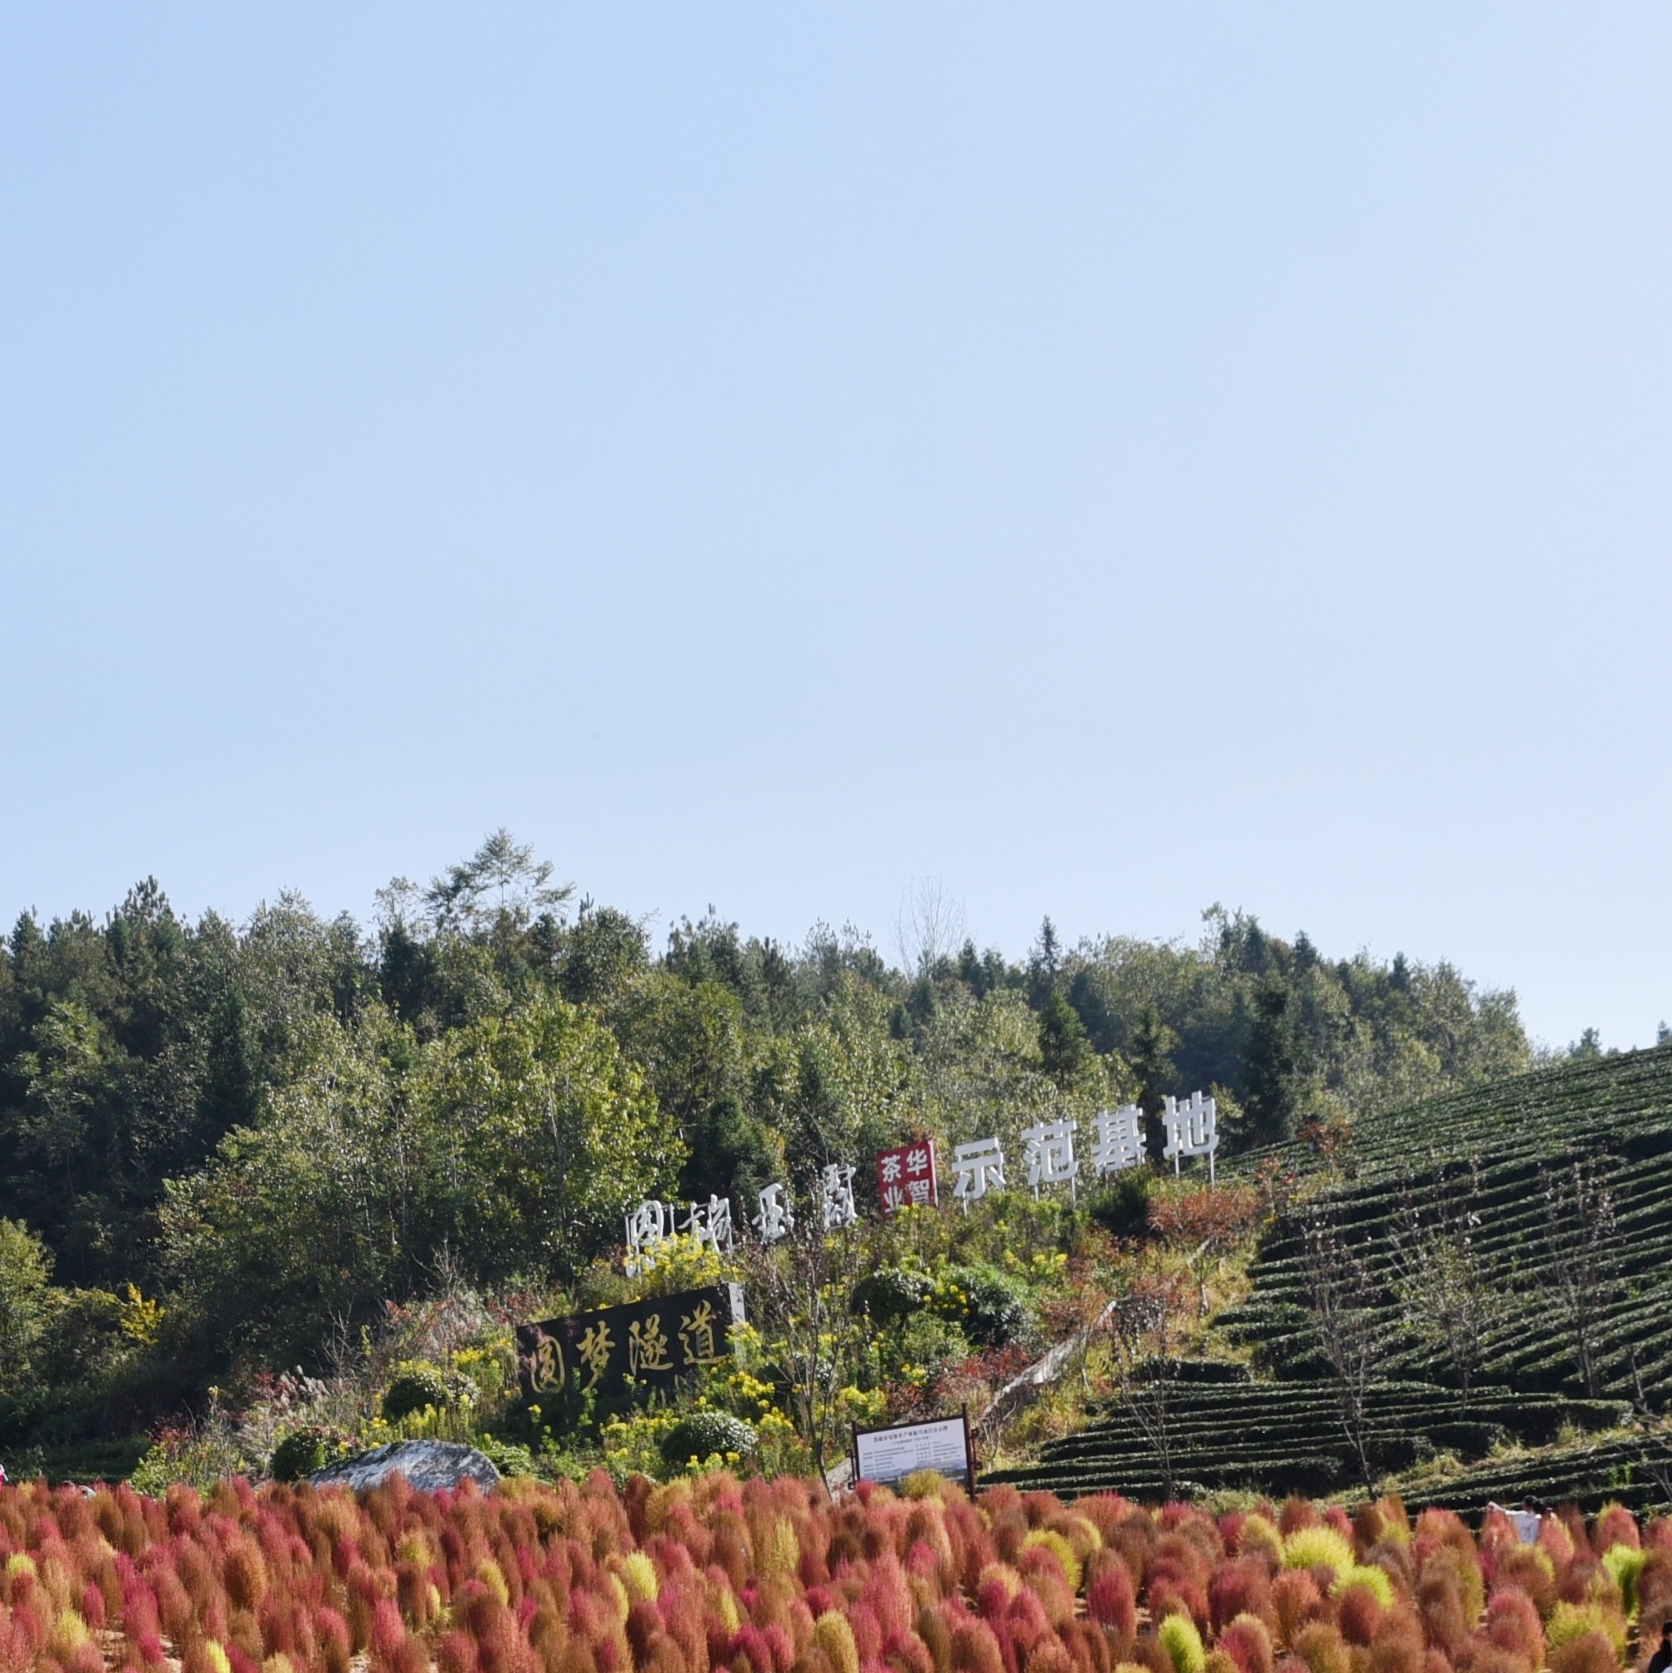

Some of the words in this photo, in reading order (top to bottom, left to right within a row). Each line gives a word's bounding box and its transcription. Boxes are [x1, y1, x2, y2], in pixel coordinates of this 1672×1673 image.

[952, 1090, 1220, 1200] 示范基地
[530, 1299, 728, 1395] 圆梦隧道
